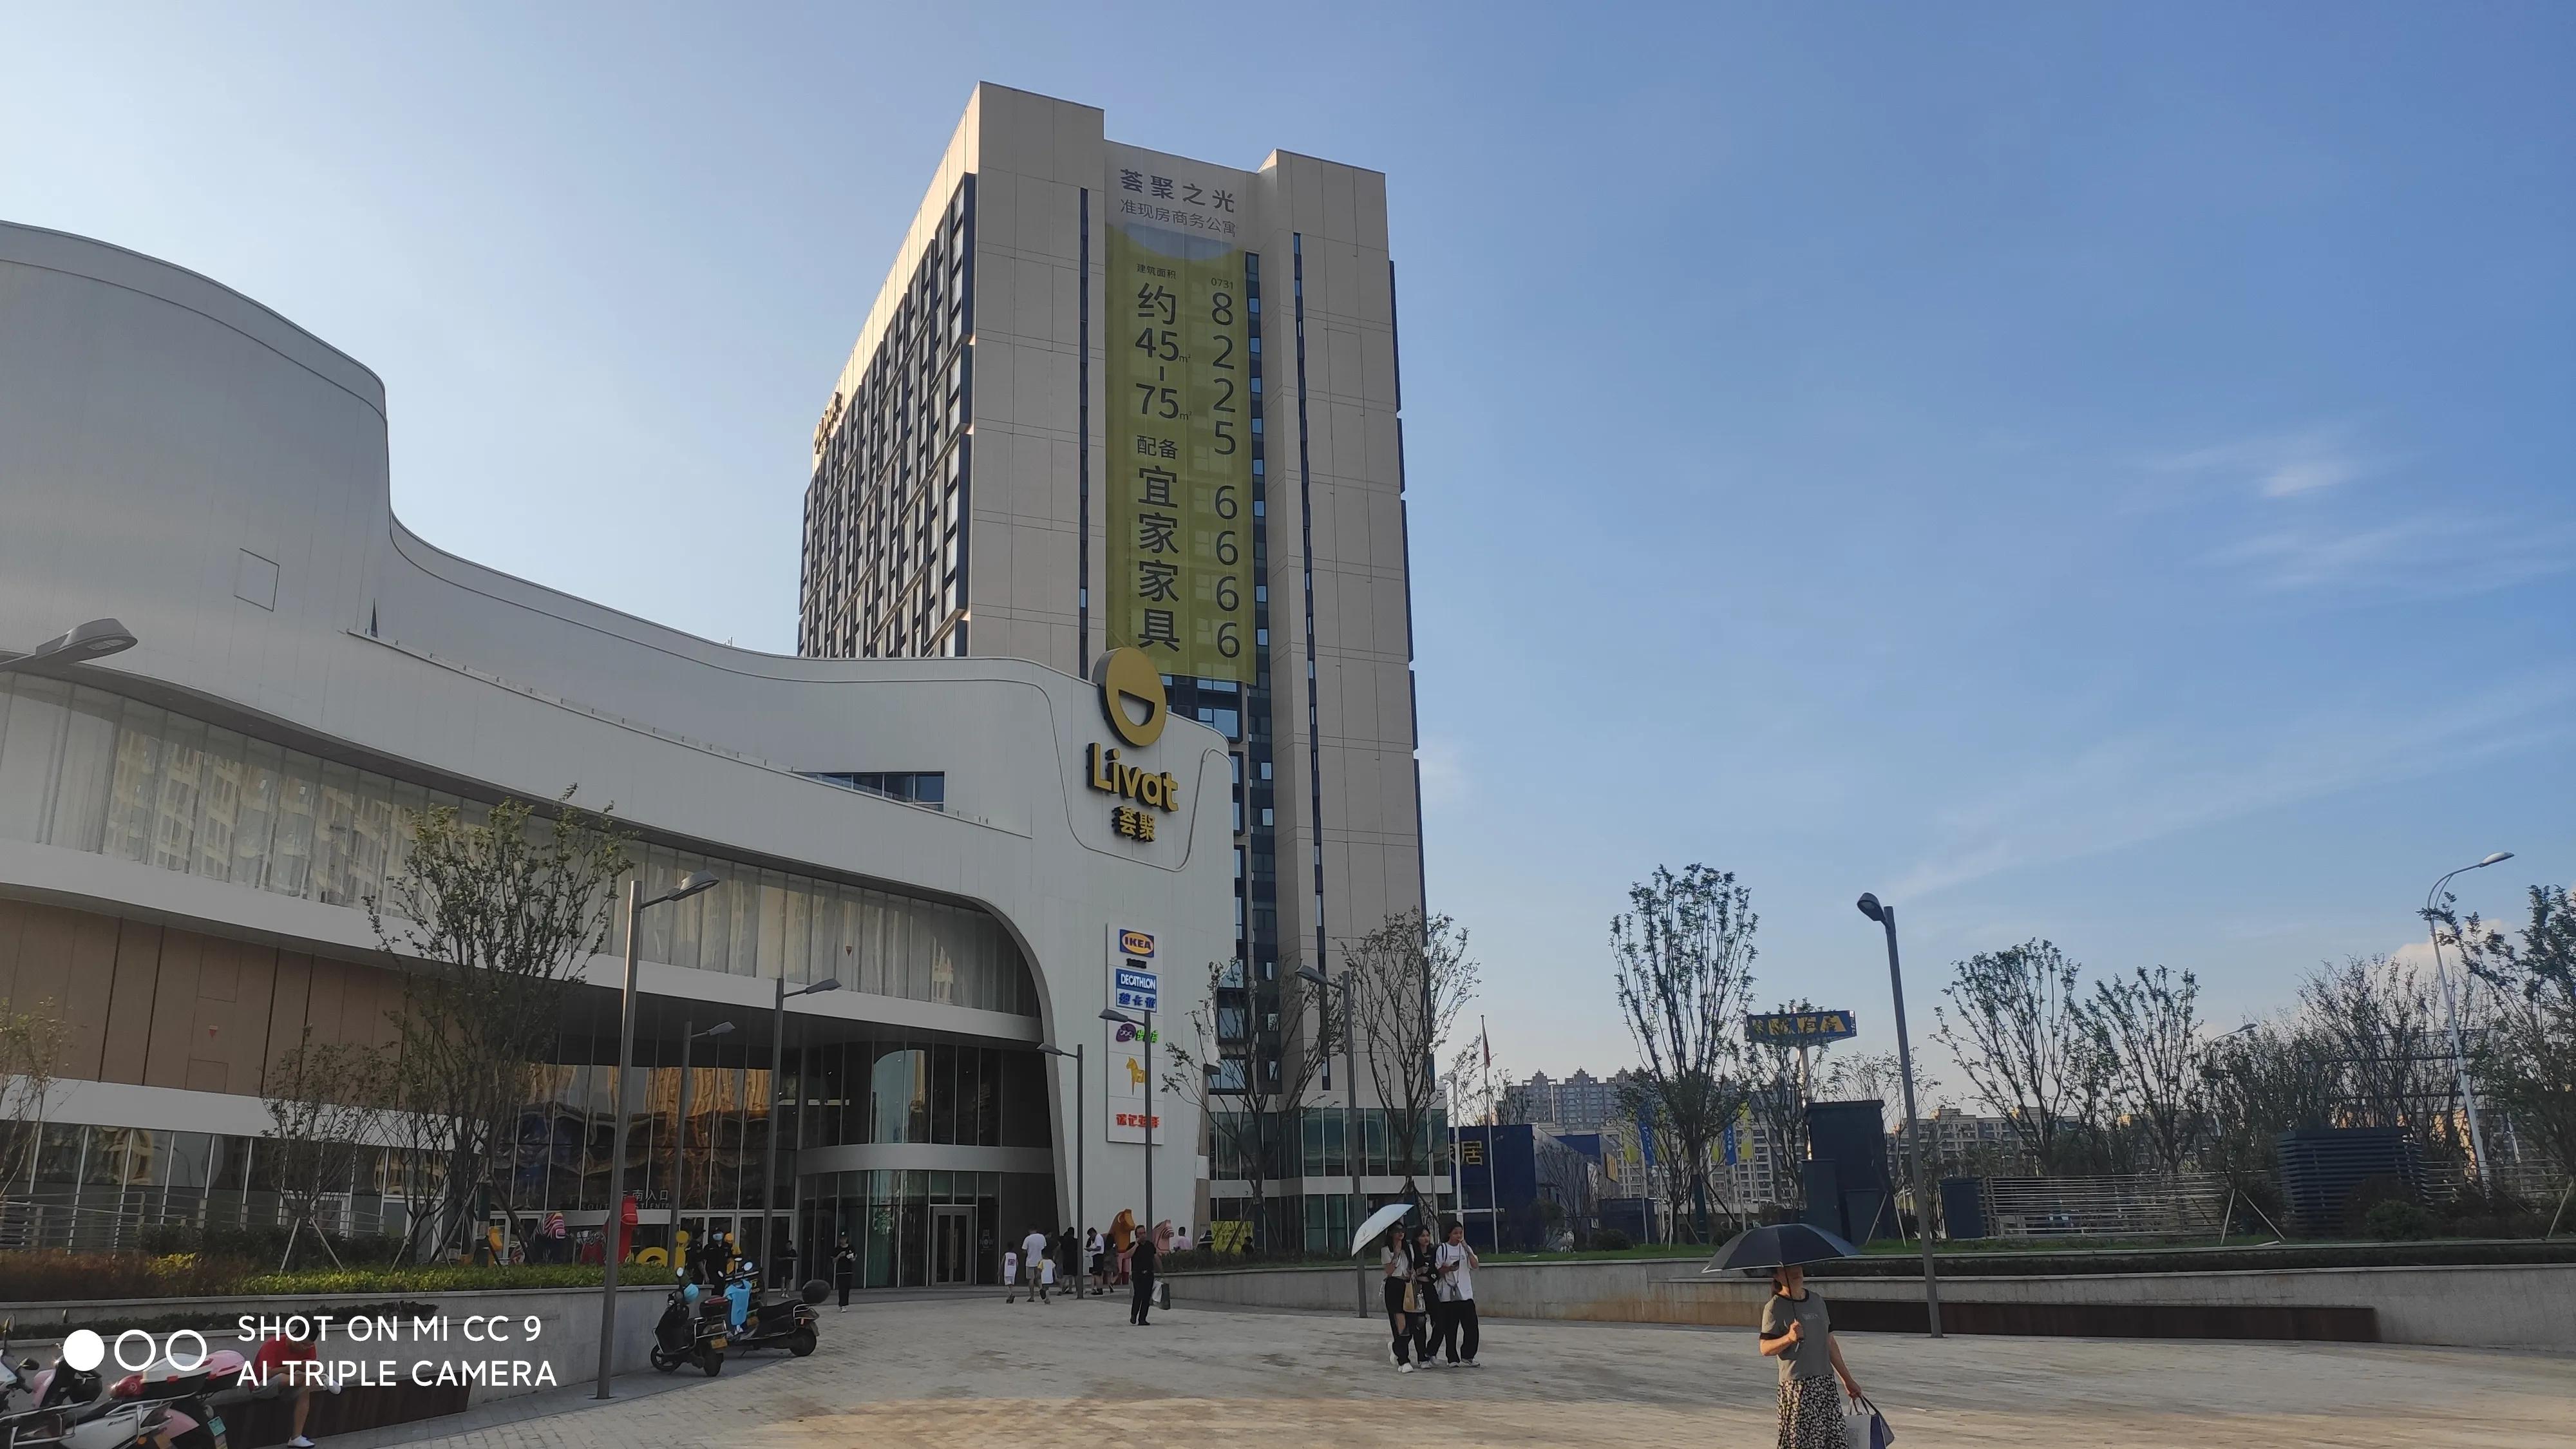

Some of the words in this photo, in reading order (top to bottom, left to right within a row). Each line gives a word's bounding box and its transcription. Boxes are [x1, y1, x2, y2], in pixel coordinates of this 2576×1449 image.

[1120, 168, 1235, 213] 荟聚之光
[1120, 198, 1236, 238] 准现房商务公寓
[1137, 263, 1176, 279] 建筑面积
[1211, 278, 1233, 289] 0731
[1137, 283, 1176, 325] 约
[1137, 434, 1178, 460] 配备
[1137, 465, 1180, 652] 宜家家具
[1088, 743, 1179, 812] Livat
[1115, 806, 1155, 842] 荟聚
[1124, 936, 1151, 950] IKEA
[1121, 973, 1156, 990] DECATHLON
